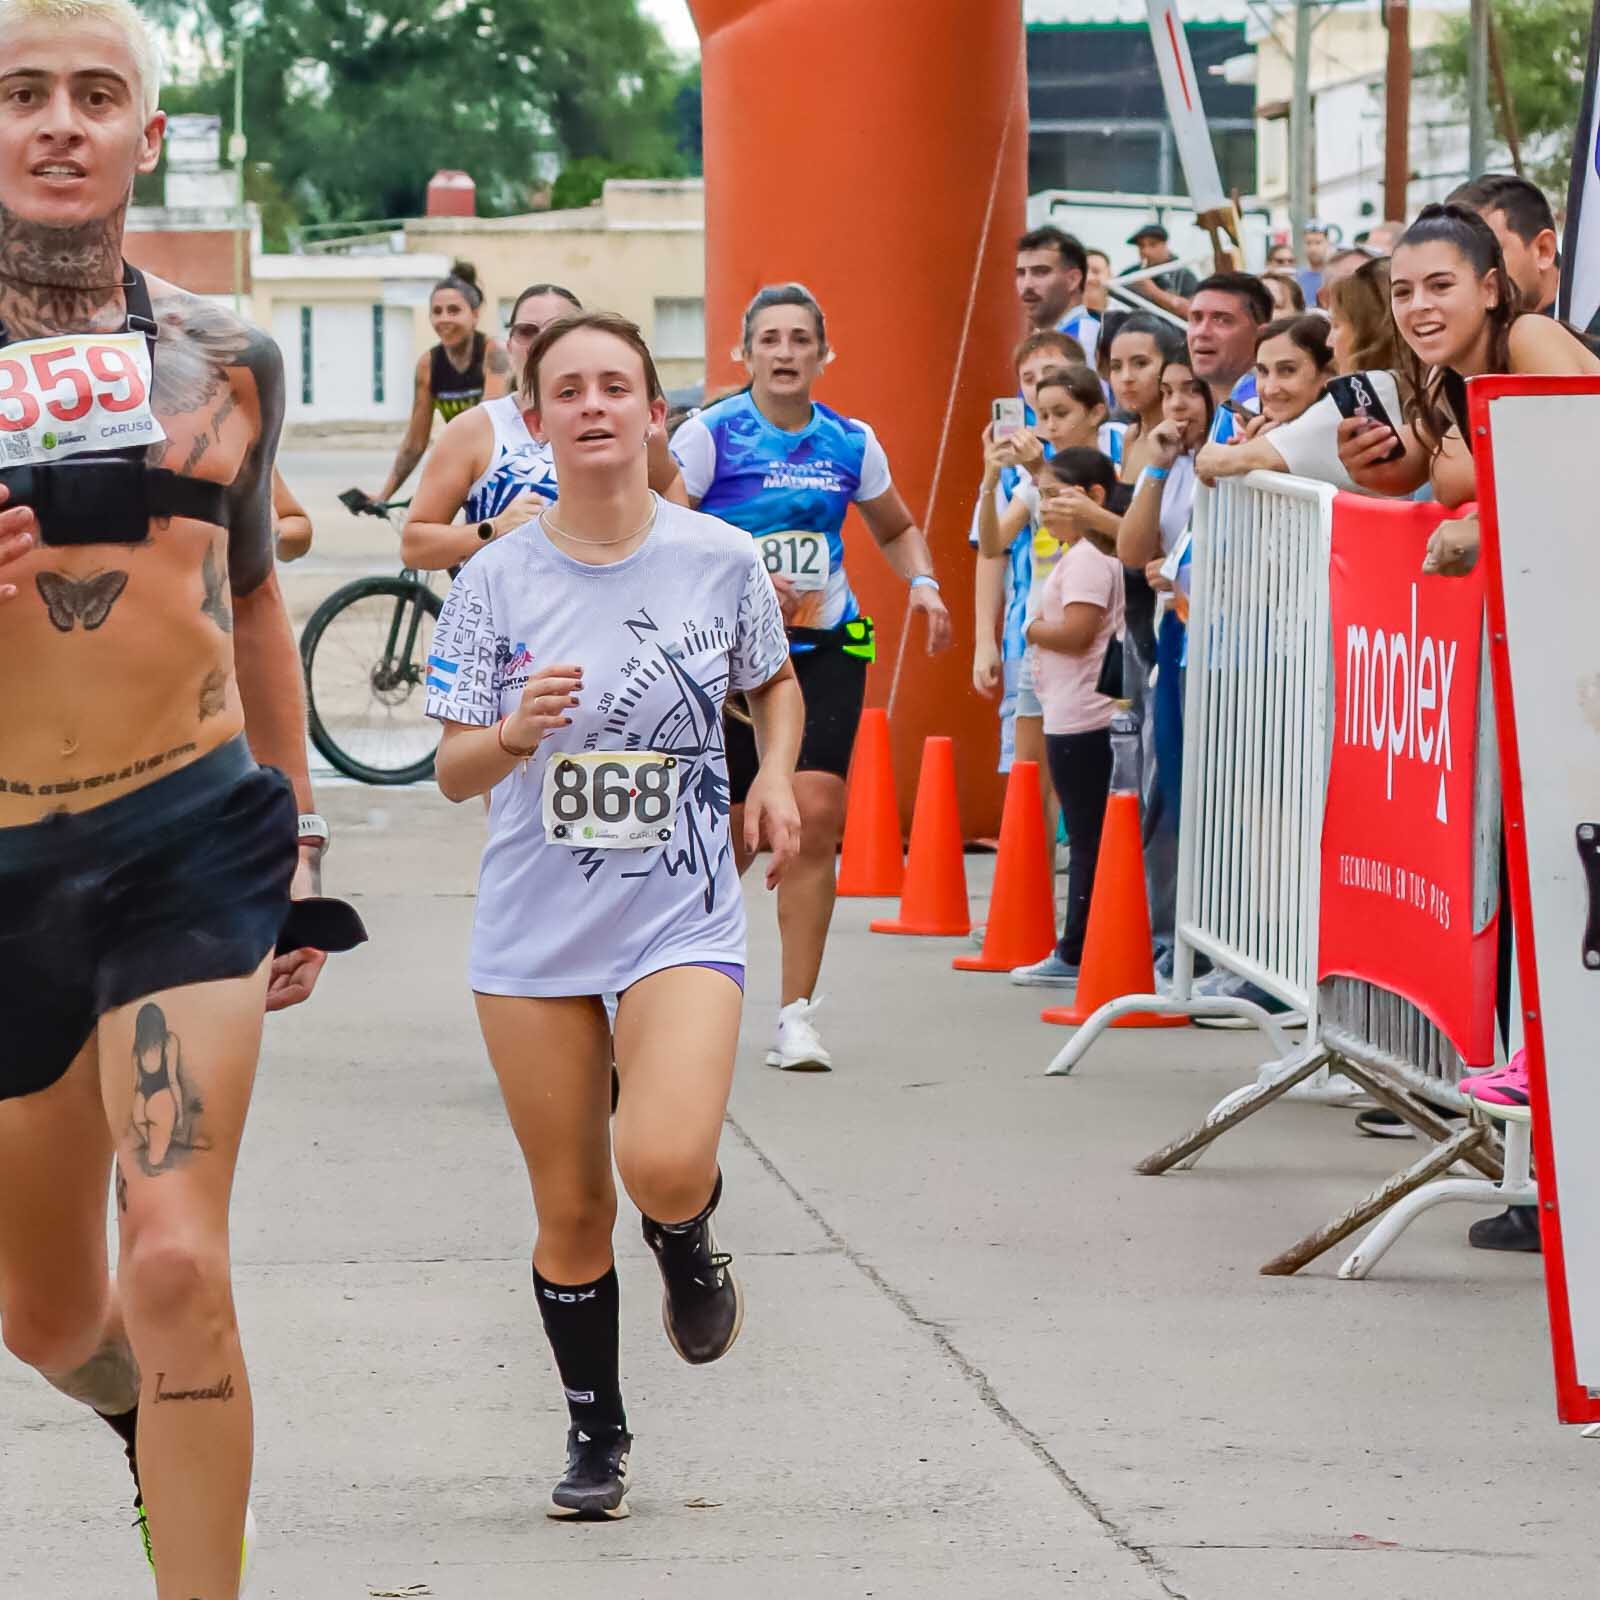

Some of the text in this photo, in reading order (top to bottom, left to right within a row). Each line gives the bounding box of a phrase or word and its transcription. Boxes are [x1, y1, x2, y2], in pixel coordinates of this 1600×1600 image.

[100, 420, 153, 439] CARUSO
[761, 536, 820, 574] 812
[622, 607, 659, 645] N
[682, 619, 697, 634] 15
[713, 616, 725, 629] 30
[620, 656, 642, 679] 345
[1344, 582, 1457, 801] moplex
[596, 692, 616, 715] 330
[584, 732, 599, 750] 315
[552, 761, 671, 824] 868
[1339, 855, 1450, 930] TECNOLOGIA EN TUS PIES
[543, 1288, 597, 1303] SOX
